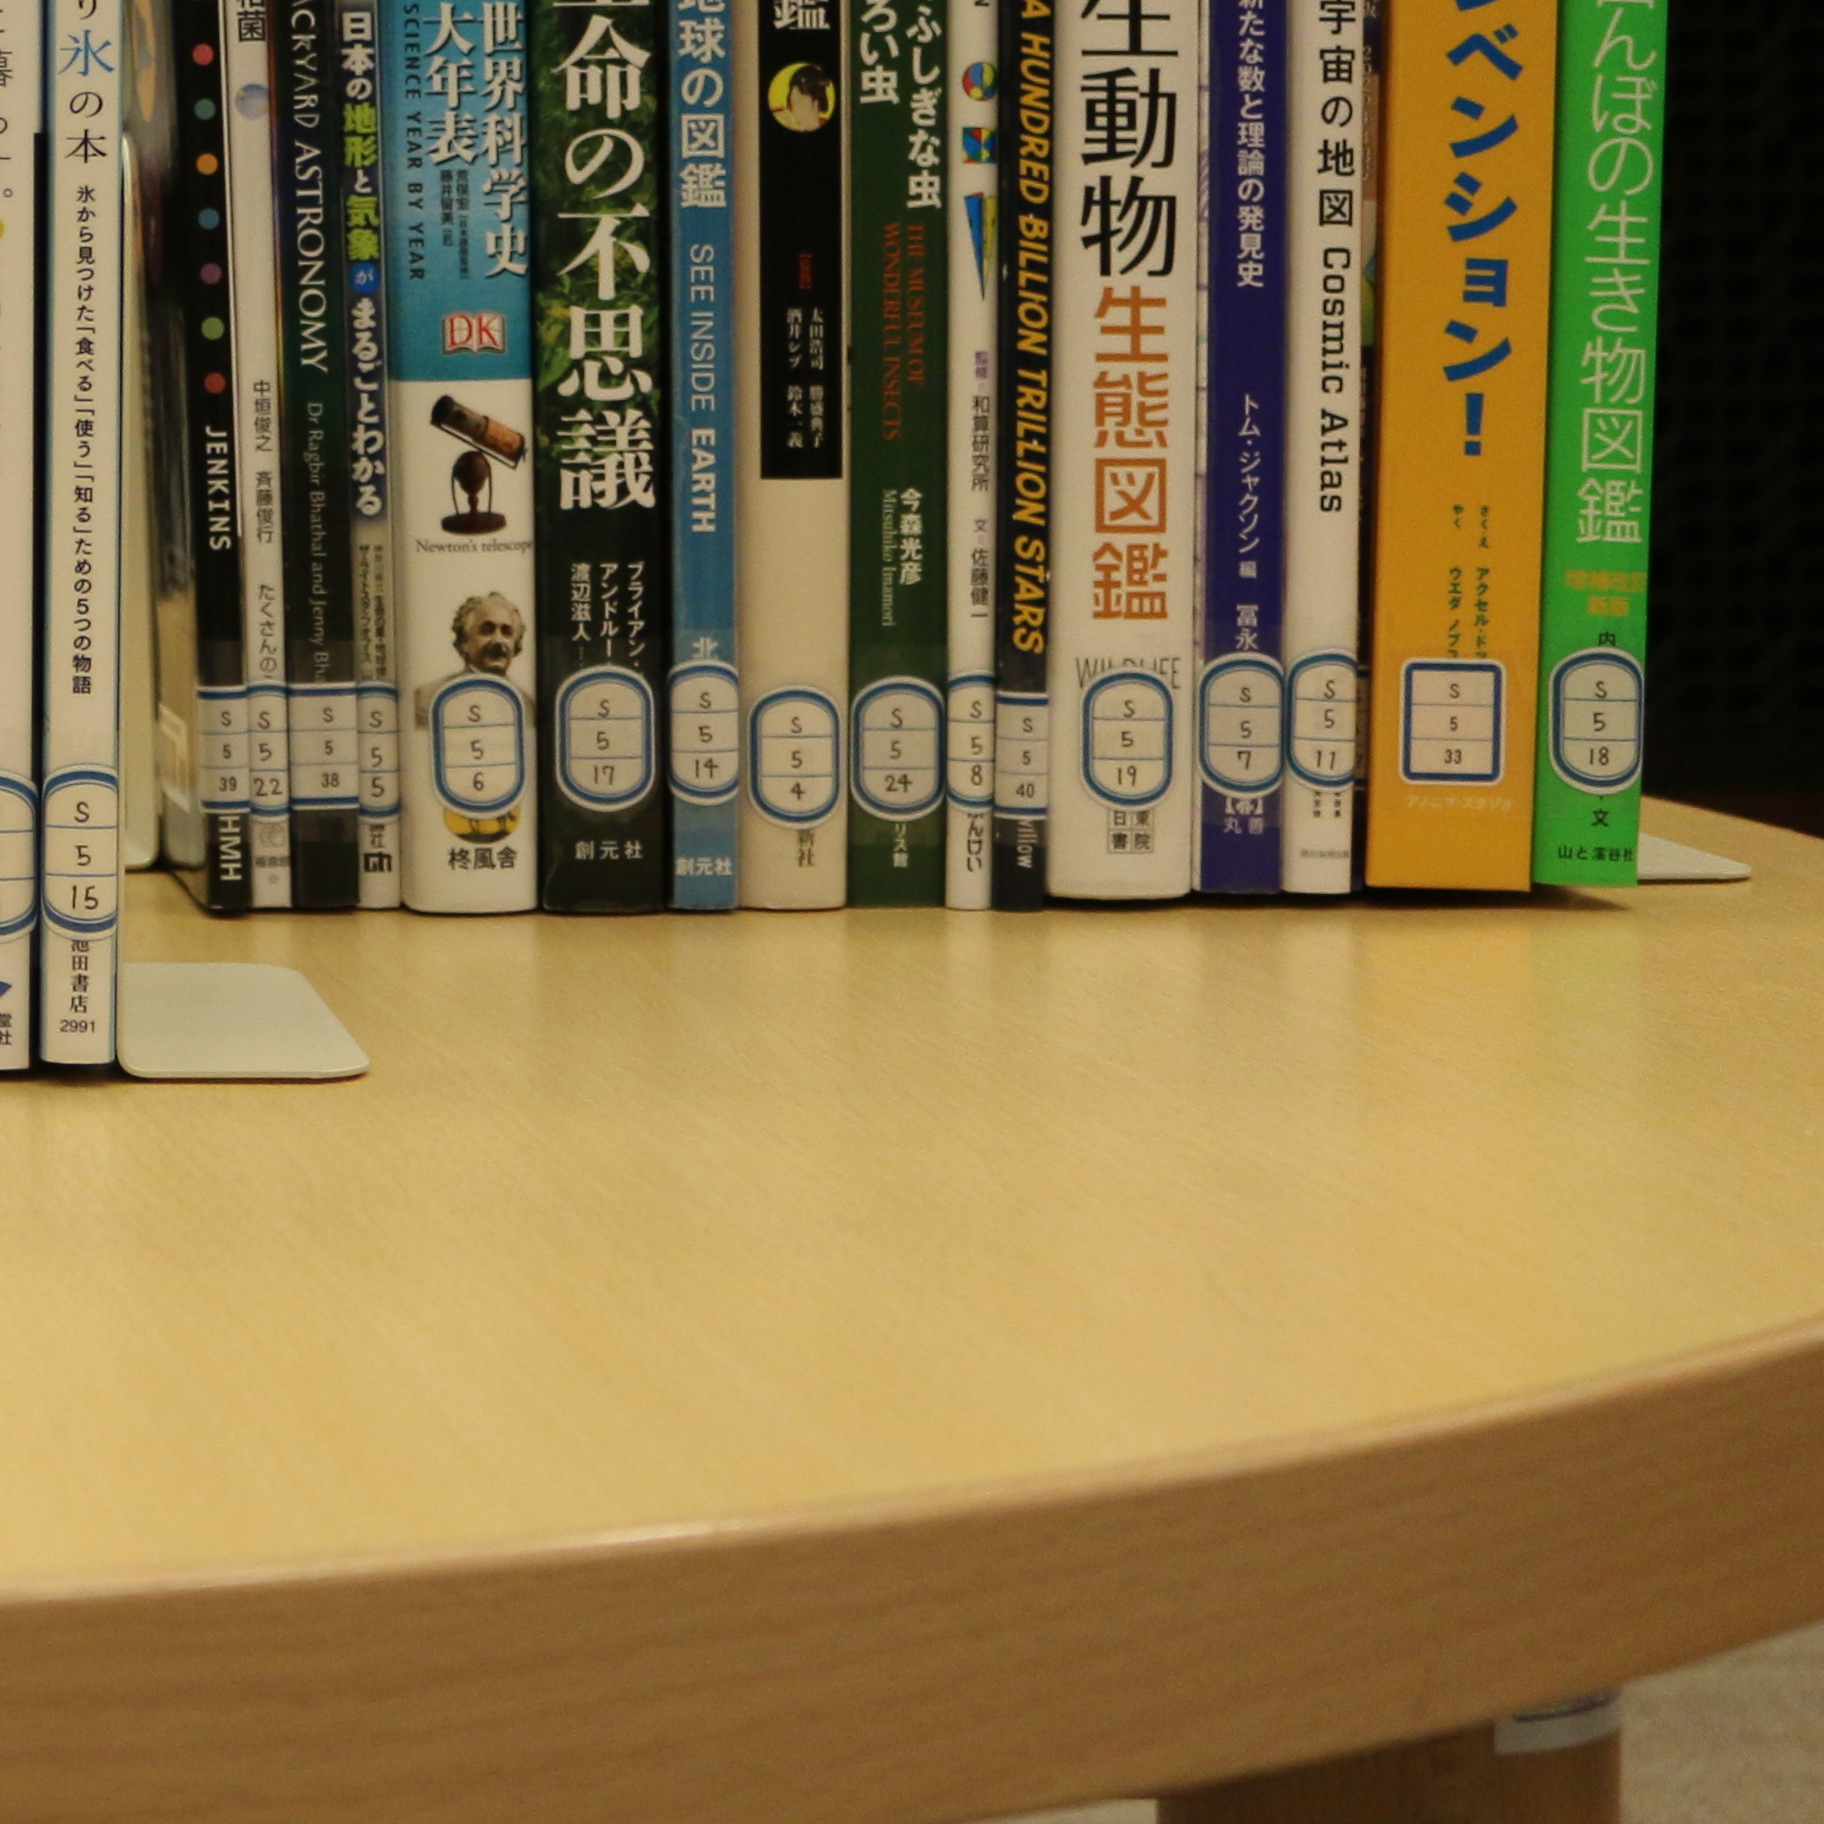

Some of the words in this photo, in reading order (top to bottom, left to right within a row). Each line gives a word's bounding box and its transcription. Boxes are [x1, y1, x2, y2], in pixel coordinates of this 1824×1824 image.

[404, 4, 421, 99] SCIENCE
[423, 2, 479, 166] 大年表
[406, 111, 423, 169] YEAR
[478, 1, 528, 277] 世界科学史
[1018, 31, 1051, 205] HUNDRED
[407, 182, 423, 212] BY
[295, 139, 328, 374] ASTRONOMY
[408, 221, 425, 280] YEAR
[690, 244, 715, 303] SEE
[1016, 213, 1050, 356] BILLION
[447, 314, 499, 348] DK
[1320, 246, 1351, 396] Cosmic
[690, 312, 716, 412] INSIDE
[1012, 368, 1048, 527] TRILLION
[1092, 285, 1170, 620] 生態図鑑
[1238, 394, 1261, 553] トム・ジャクソン
[1319, 408, 1348, 514] Atlas
[205, 426, 231, 550] JENKINS
[691, 428, 716, 532] EARTH
[415, 540, 478, 553] Newton's
[482, 540, 534, 554] telescope
[1011, 535, 1047, 655] STARS
[468, 706, 482, 722] S
[1239, 687, 1251, 703] S
[1595, 681, 1607, 698] S
[471, 740, 484, 760] 5
[1240, 721, 1251, 738] 5
[1593, 713, 1606, 732] 5
[472, 773, 485, 791] 6
[1237, 750, 1251, 770] 7
[1589, 748, 1610, 766] 18
[60, 1019, 96, 1033] 2991
